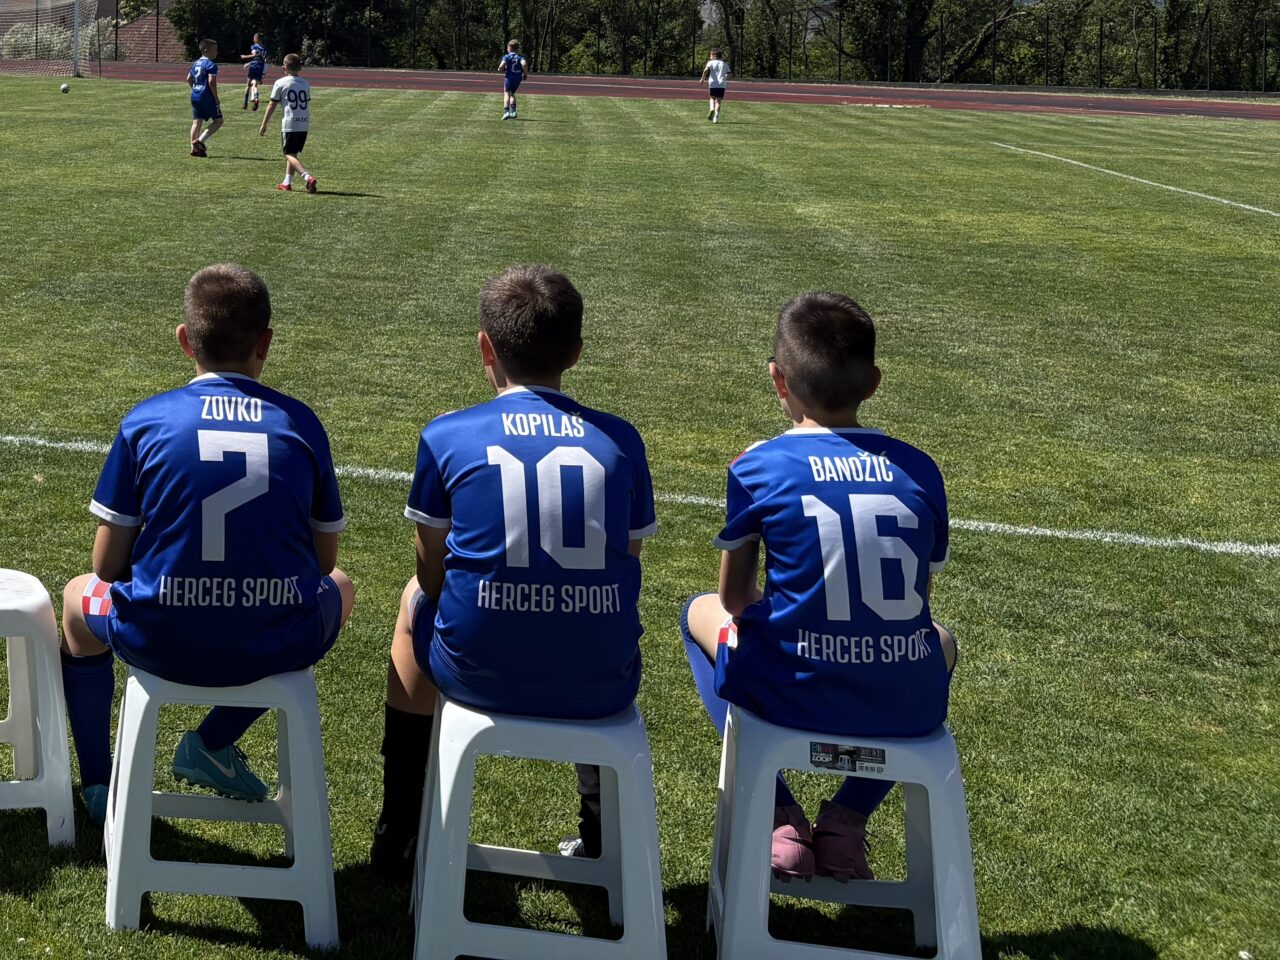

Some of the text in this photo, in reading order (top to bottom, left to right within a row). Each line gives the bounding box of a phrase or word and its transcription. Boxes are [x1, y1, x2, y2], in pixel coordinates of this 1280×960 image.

[287, 89, 308, 110] 99
[200, 395, 263, 423] ZOVKO
[501, 411, 585, 438] KOPILAŠ
[808, 451, 895, 483] BANOŽIĆ
[197, 429, 270, 562] 7
[486, 445, 607, 570] 10
[801, 493, 925, 622] 16
[158, 575, 304, 608] HERCEG SPORT
[477, 579, 621, 614] HERCEG SPORT
[797, 627, 933, 665] HERCEG SPORT
